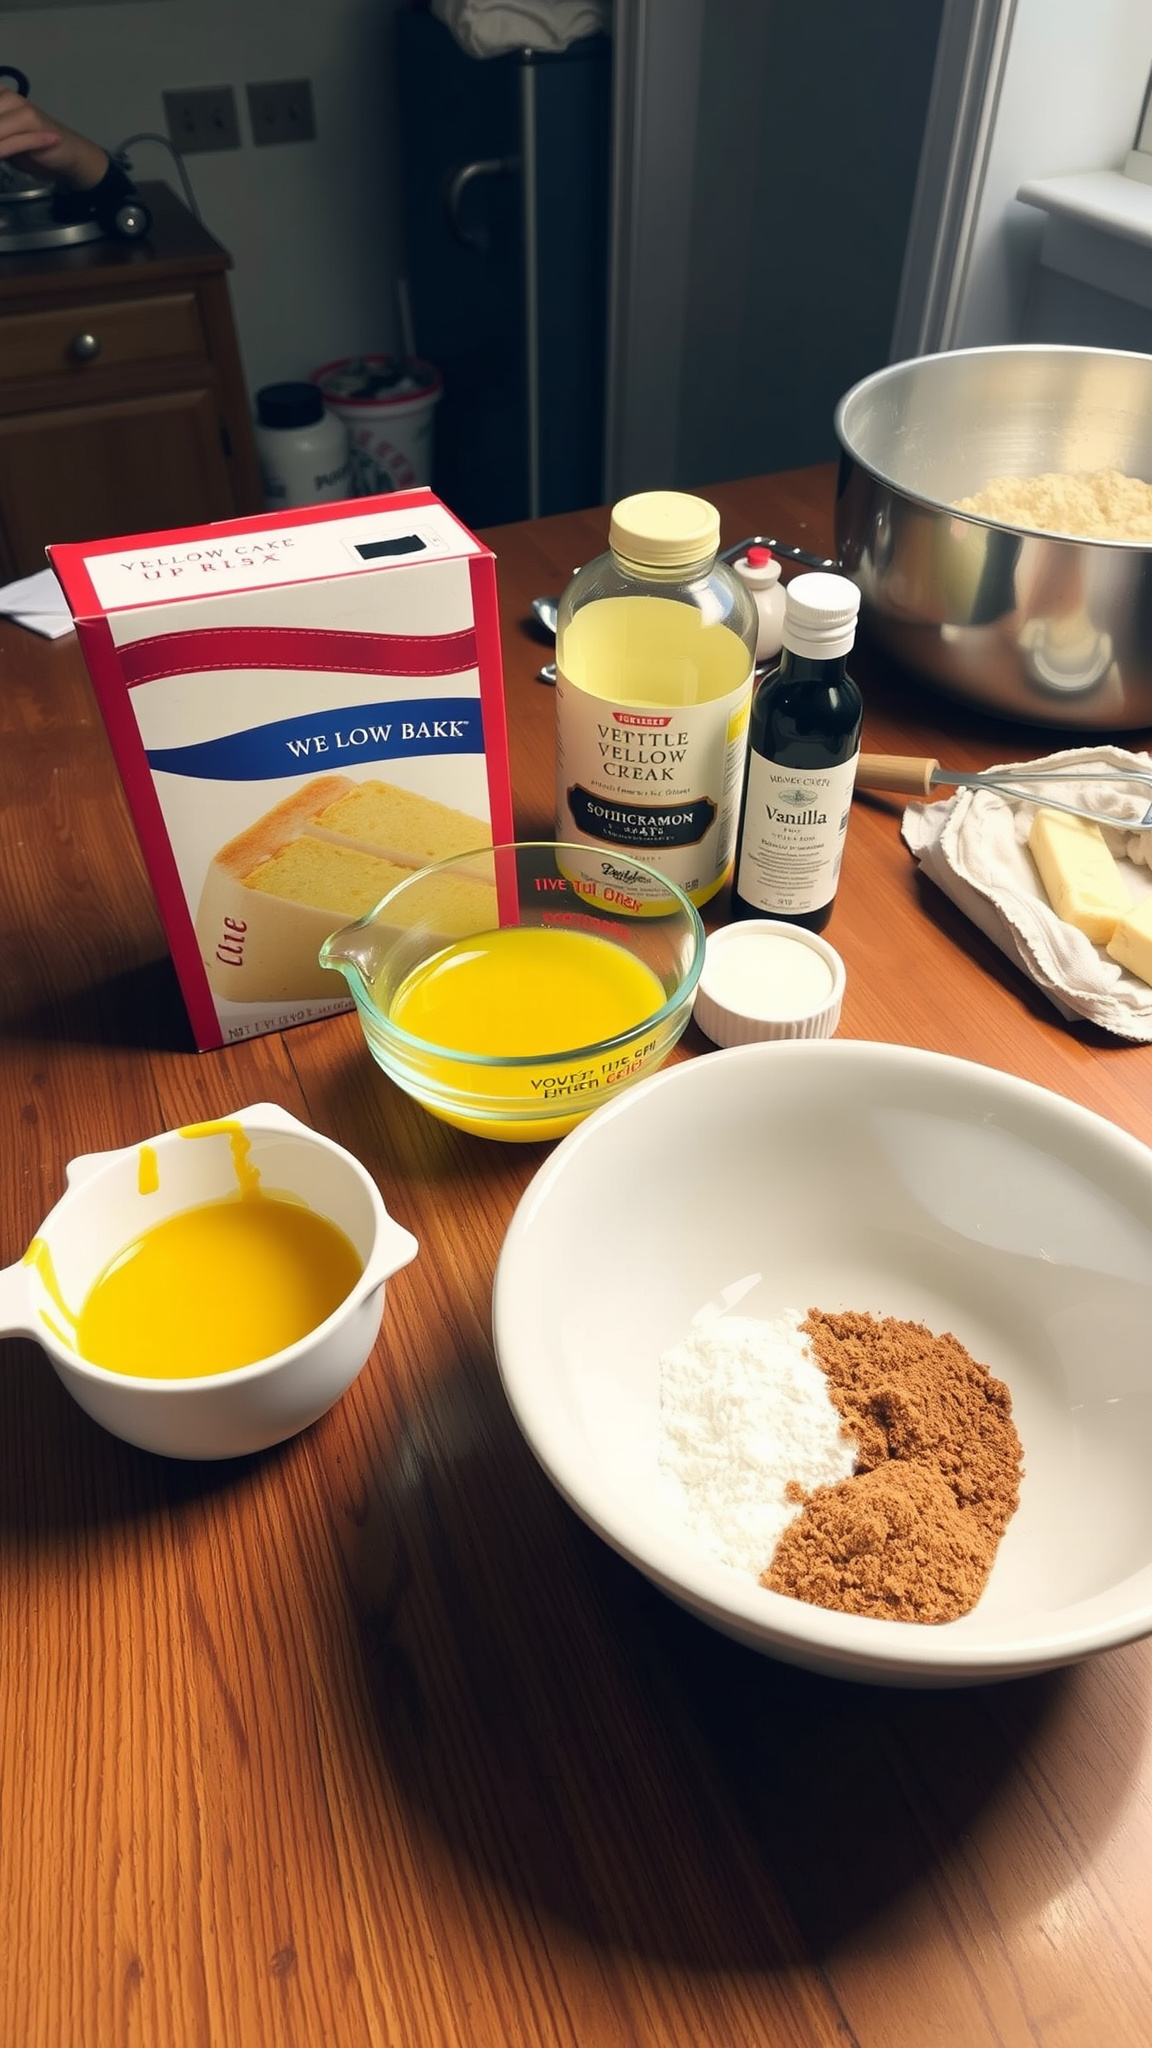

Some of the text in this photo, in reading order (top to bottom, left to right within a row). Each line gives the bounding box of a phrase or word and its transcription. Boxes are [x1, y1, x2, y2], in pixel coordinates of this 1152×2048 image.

[120, 538, 295, 571] YELLOW CAKE
[286, 735, 329, 757] WE
[335, 724, 392, 748] LOW
[603, 762, 674, 780] CREAK
